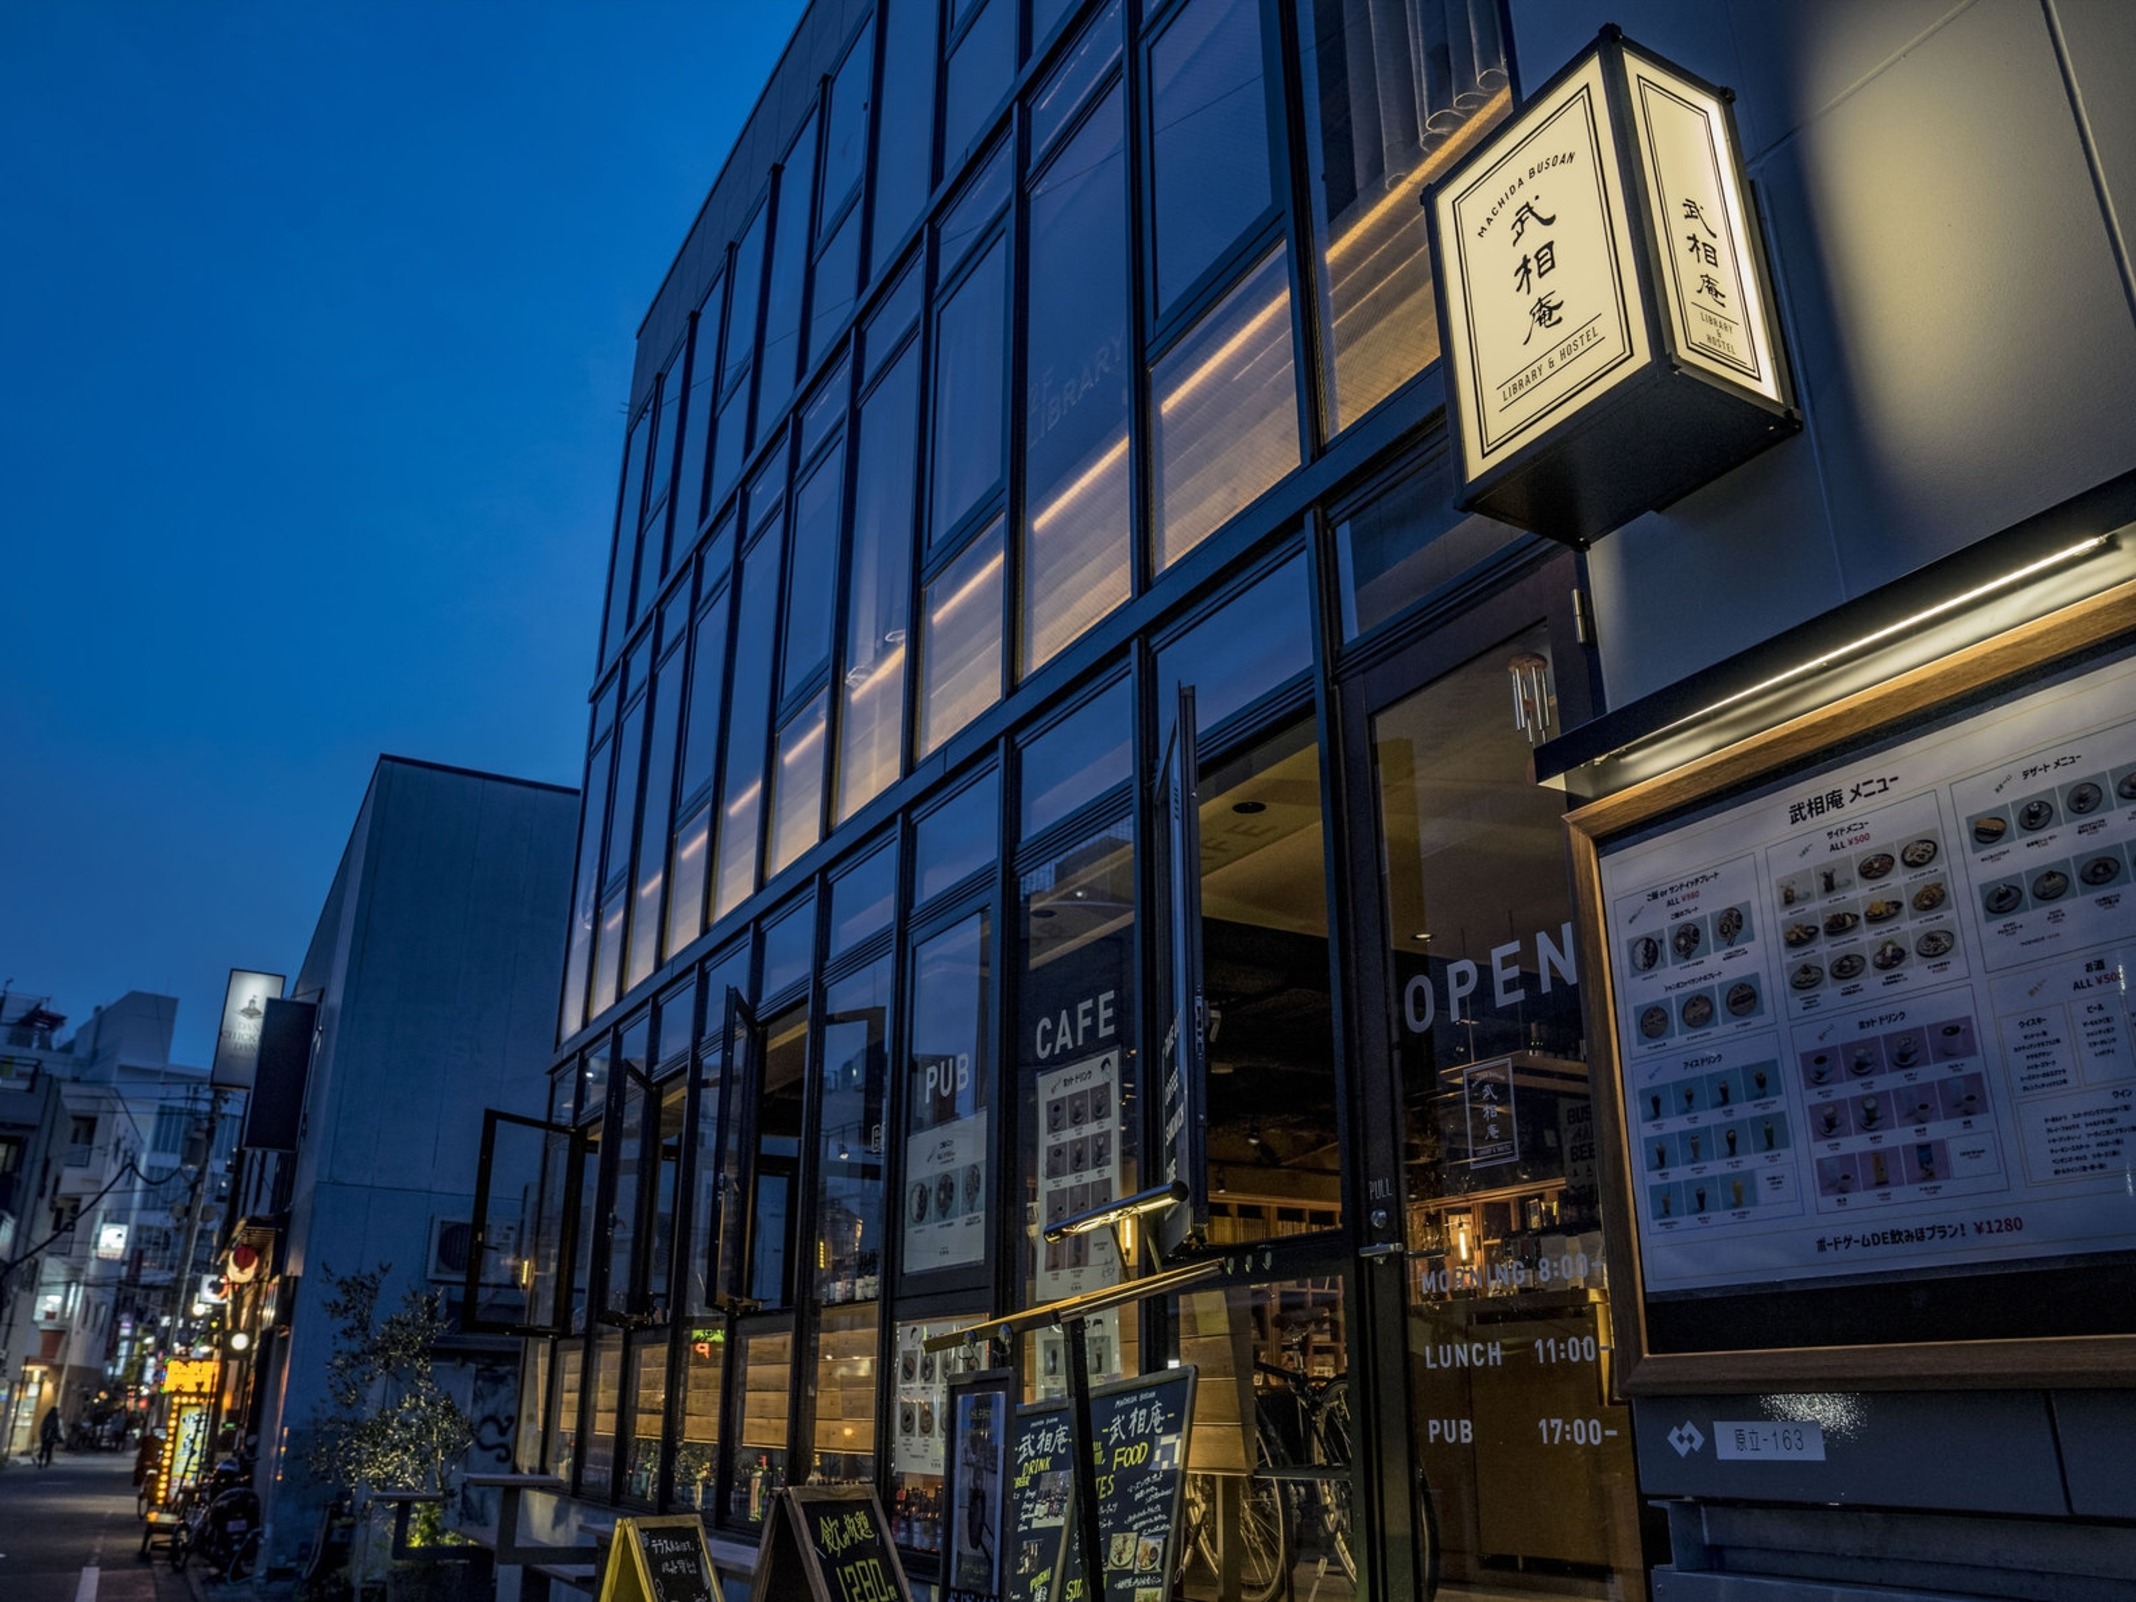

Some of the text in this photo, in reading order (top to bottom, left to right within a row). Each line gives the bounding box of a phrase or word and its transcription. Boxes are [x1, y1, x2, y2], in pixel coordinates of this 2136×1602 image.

[1477, 151, 1576, 238] MACHIDA BUSOAN
[1510, 194, 1565, 345] 武相庵
[1682, 198, 1726, 308] 武相庵
[1700, 312, 1733, 335] LIBRARY
[1706, 333, 1736, 355] HOSTEL
[1501, 326, 1599, 402] LIBRARY & HOSTEL
[1789, 776, 1899, 825] 武相庵 メニュー
[1829, 833, 1870, 853] ALL ¥500
[1404, 921, 1578, 1034] OPEN
[2073, 978, 2093, 991] ALL
[1036, 990, 1114, 1060] CAFE
[925, 1053, 969, 1103] PUB
[1369, 1177, 1392, 1200] PULL
[1973, 1216, 2024, 1236] ¥1280
[1421, 1260, 1525, 1295] MORNING
[1425, 1341, 1501, 1369] LUNCH
[1109, 1400, 1165, 1446] 武相庵
[1428, 1418, 1617, 1445] PUB 17:00-
[1017, 1424, 1069, 1465] 武相庵
[1113, 1442, 1148, 1471] FOOD
[1022, 1456, 1052, 1477] DRINK
